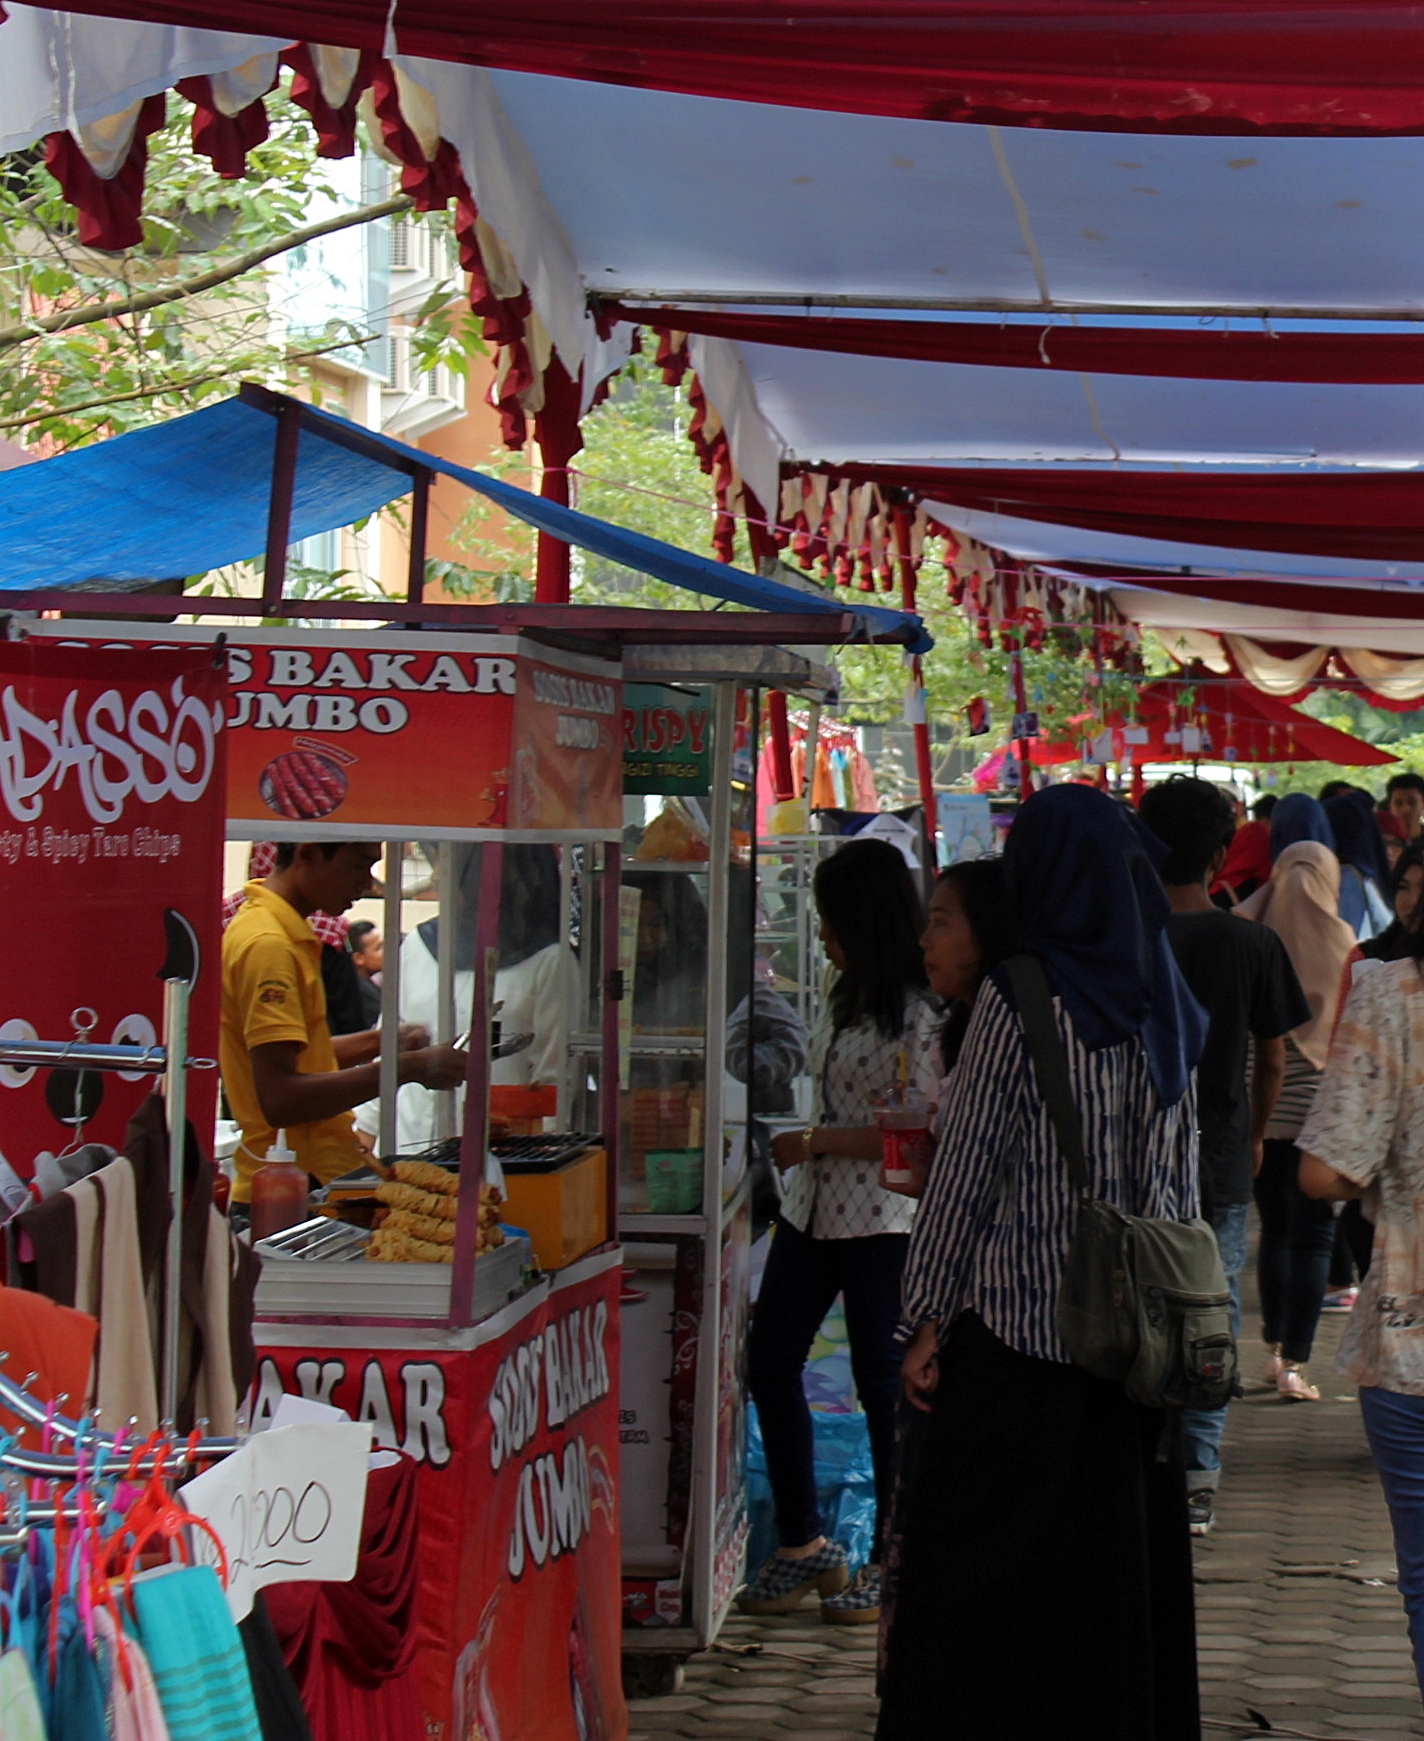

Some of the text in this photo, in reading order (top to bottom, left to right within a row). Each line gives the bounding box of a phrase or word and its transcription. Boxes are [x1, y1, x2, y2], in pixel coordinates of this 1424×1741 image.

[267, 650, 517, 694] BAKAR
[622, 707, 708, 755] RISPY
[41, 825, 90, 865] Spicy
[133, 826, 181, 863] Chips
[251, 1357, 453, 1468] AKAR
